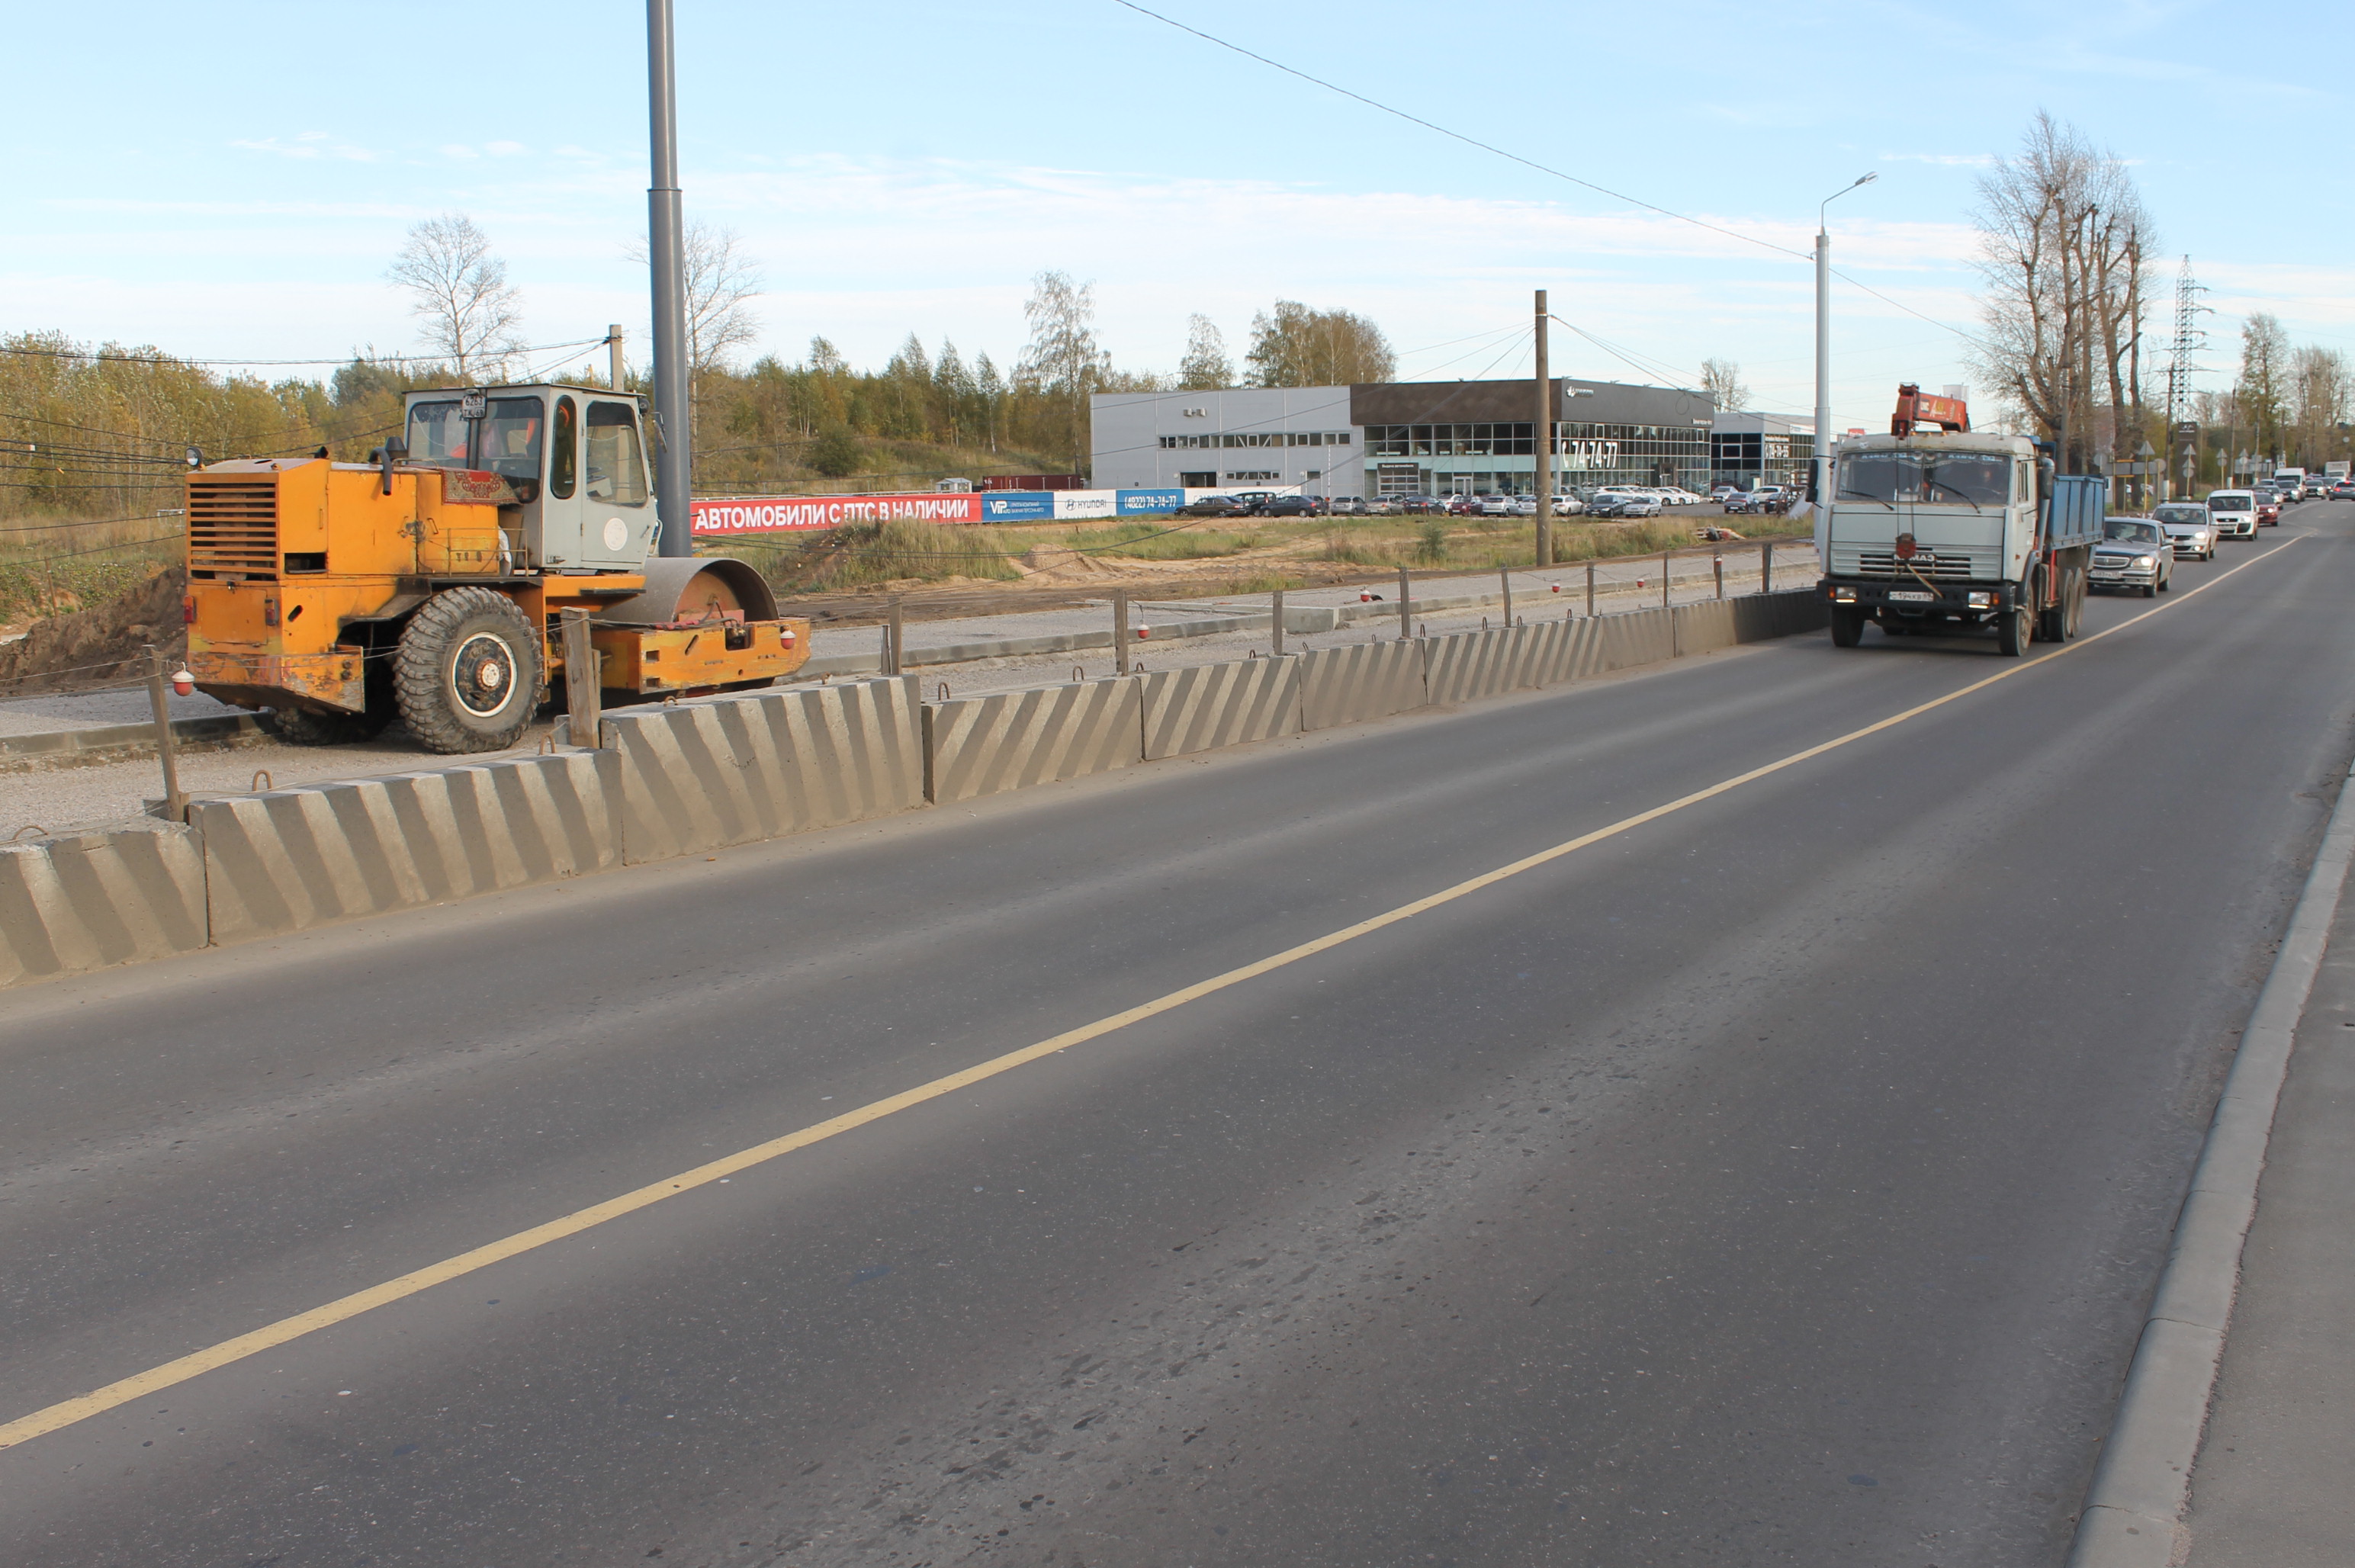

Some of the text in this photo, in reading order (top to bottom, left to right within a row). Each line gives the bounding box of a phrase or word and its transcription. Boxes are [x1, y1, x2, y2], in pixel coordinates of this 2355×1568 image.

[465, 396, 483, 406] 6263
[1572, 441, 1618, 468] 74-74-77
[989, 500, 1008, 514] VIP
[1078, 499, 1107, 509] HYUNDAI
[1124, 495, 1177, 509] (4822) 74-74-77
[695, 500, 969, 529] АВТОМОБИЛИ С ПТС В НАЛИЧИИ
